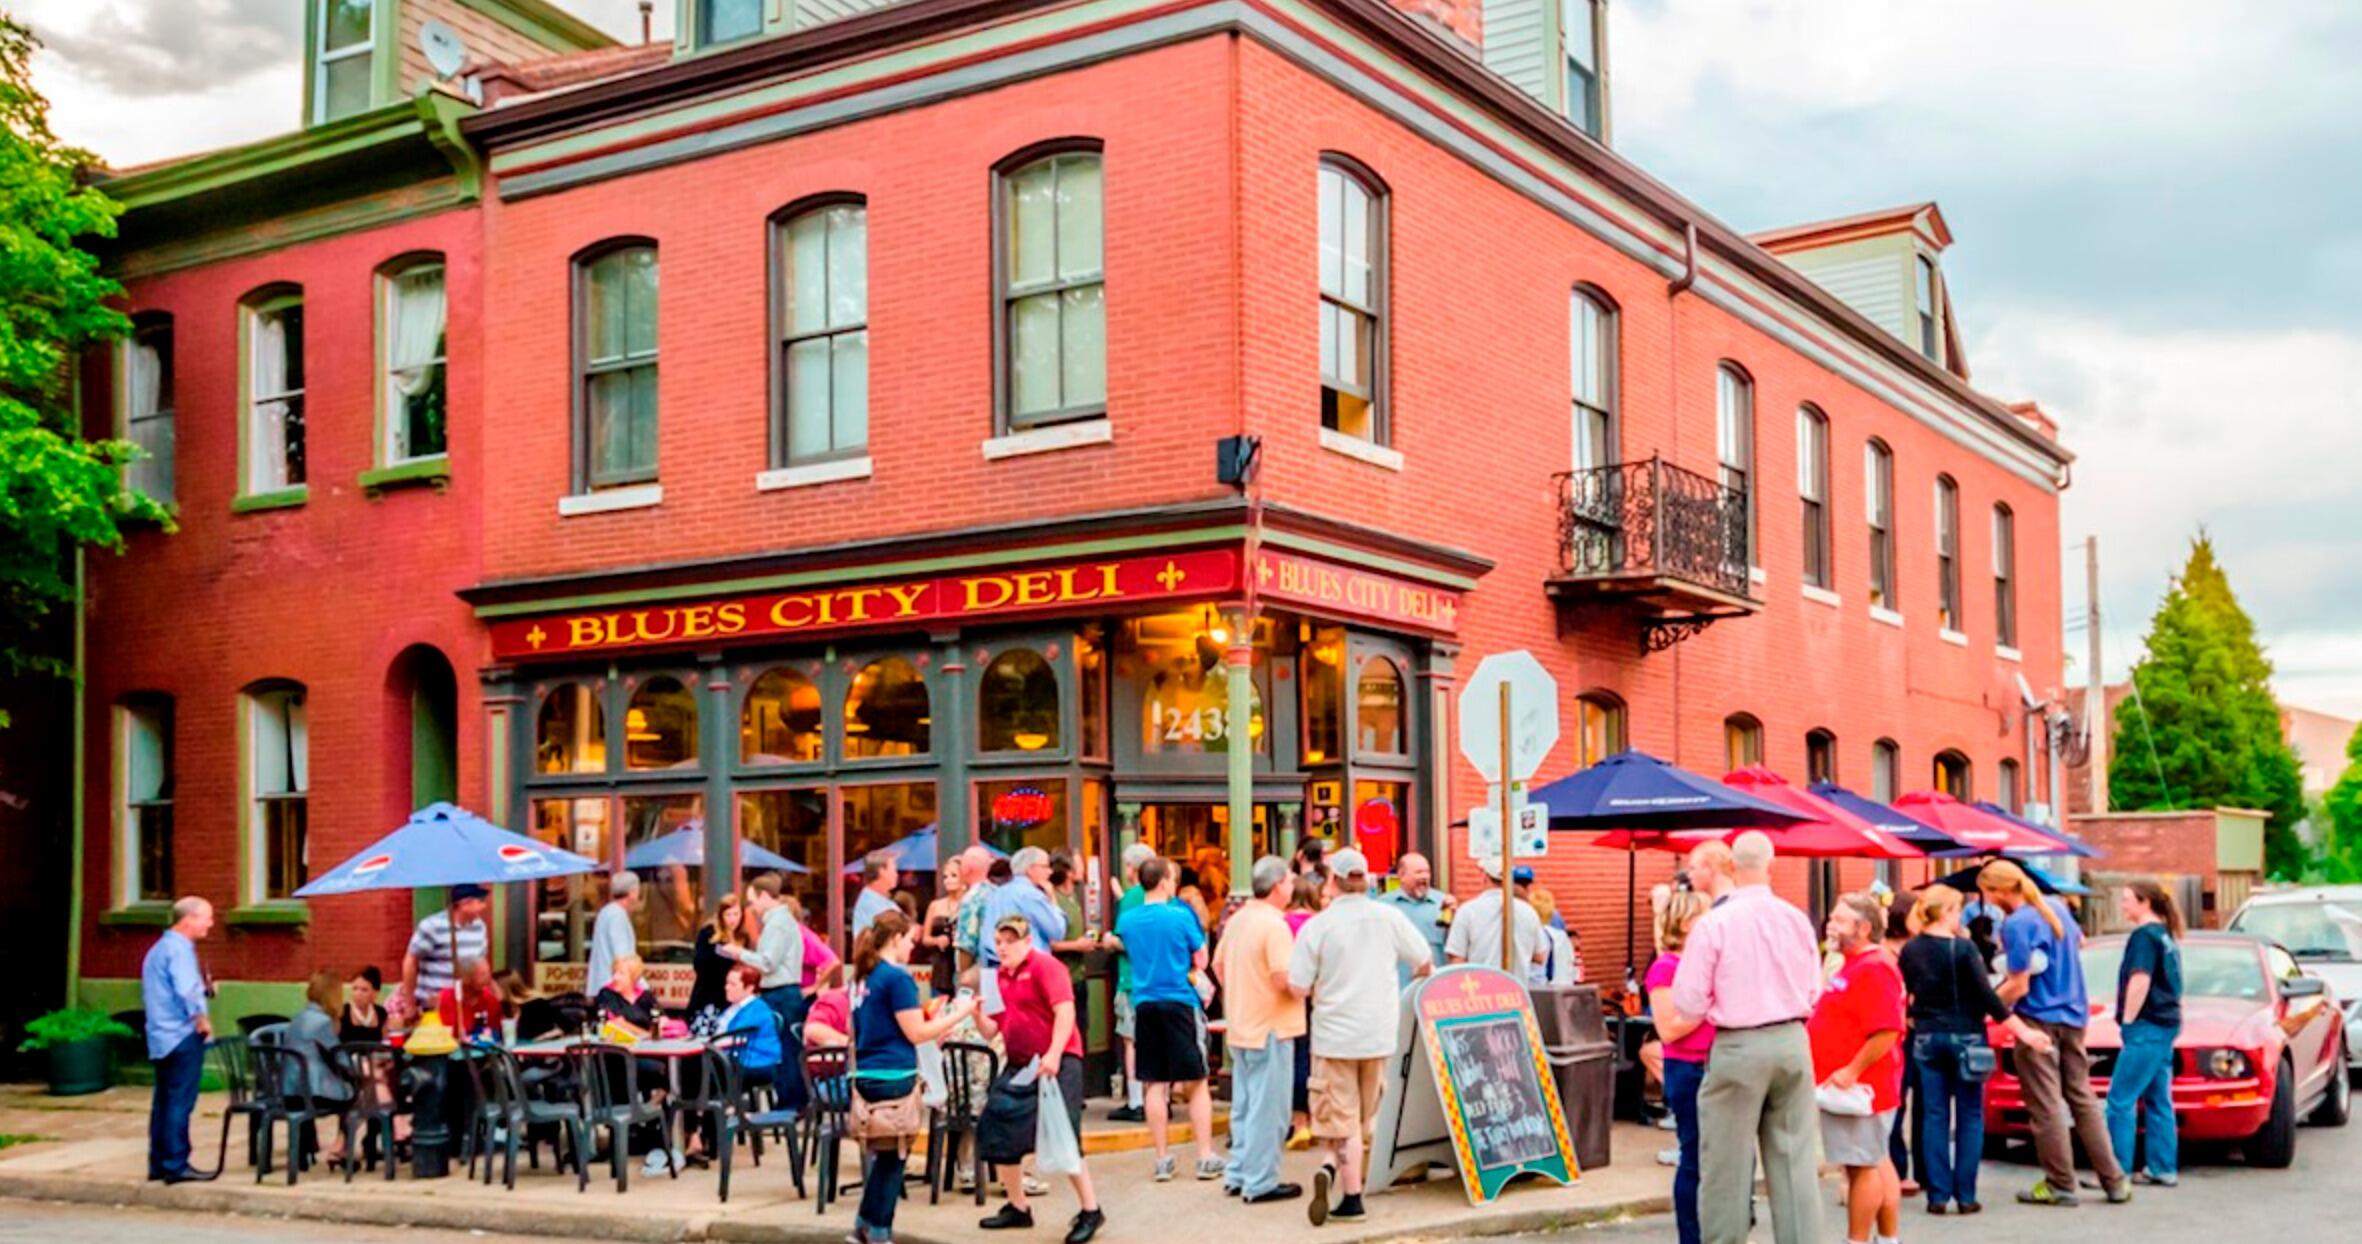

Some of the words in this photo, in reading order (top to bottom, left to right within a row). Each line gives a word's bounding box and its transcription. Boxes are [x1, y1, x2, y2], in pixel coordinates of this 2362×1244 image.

[567, 603, 747, 647] BLUES
[769, 583, 931, 627] CITY
[960, 563, 1125, 611] DELI
[1278, 560, 1342, 604] BLUES
[1346, 575, 1392, 612] CITY
[1399, 586, 1438, 622] DELI
[993, 792, 1055, 822] OPEN
[546, 965, 588, 981] PO-BO
